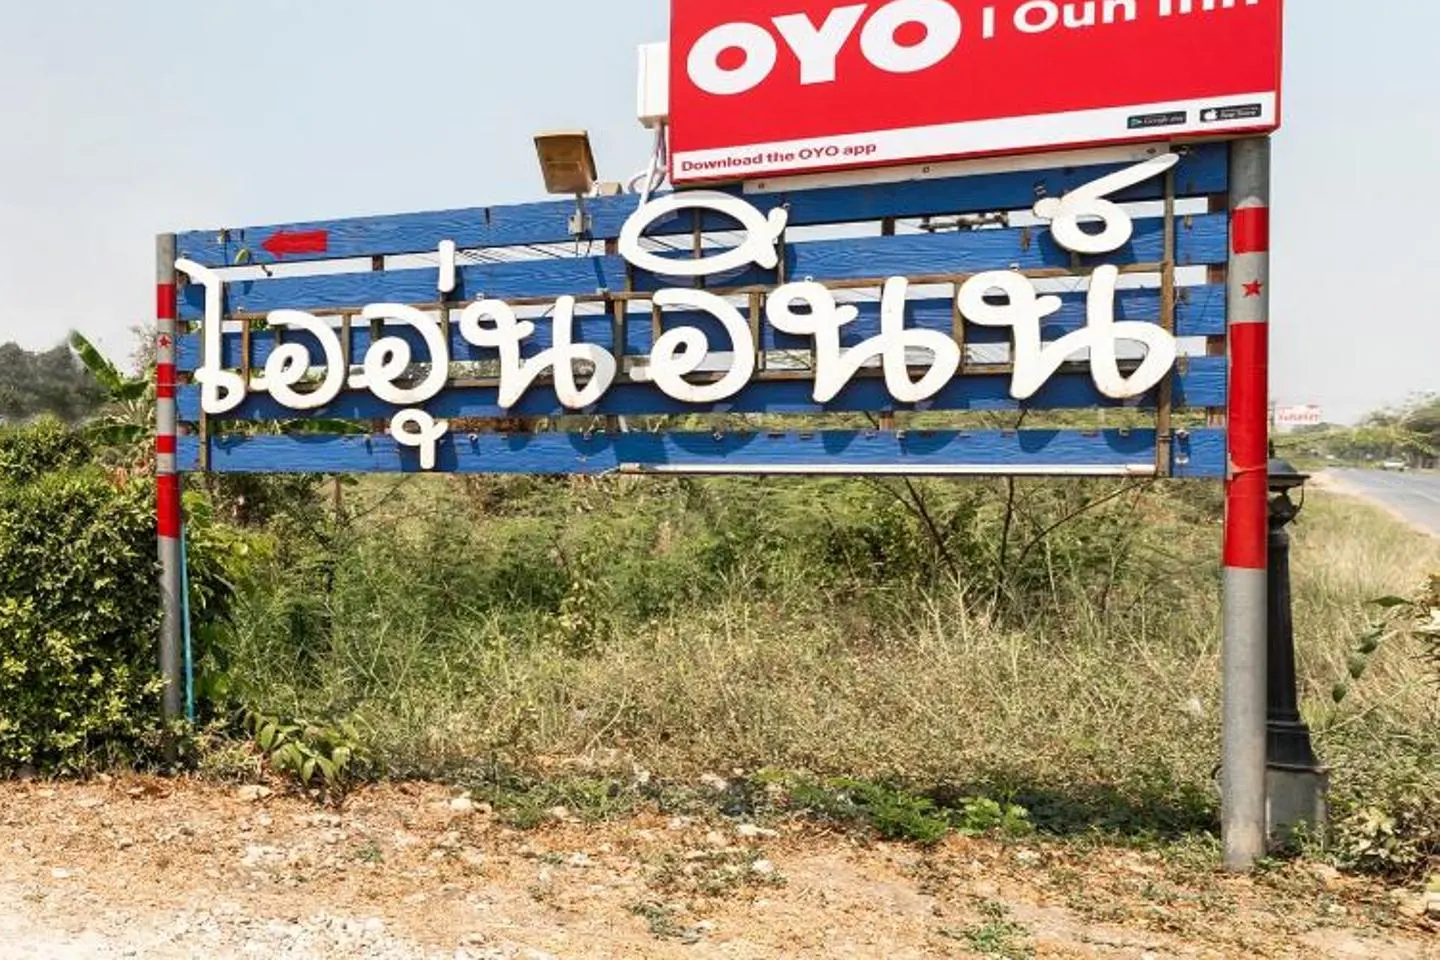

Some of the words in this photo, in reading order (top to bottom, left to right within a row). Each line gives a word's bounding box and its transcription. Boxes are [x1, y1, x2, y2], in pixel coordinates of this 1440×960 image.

[681, 152, 763, 172] Download
[766, 151, 796, 163] the
[798, 144, 839, 160] OYO
[843, 142, 878, 157] app
